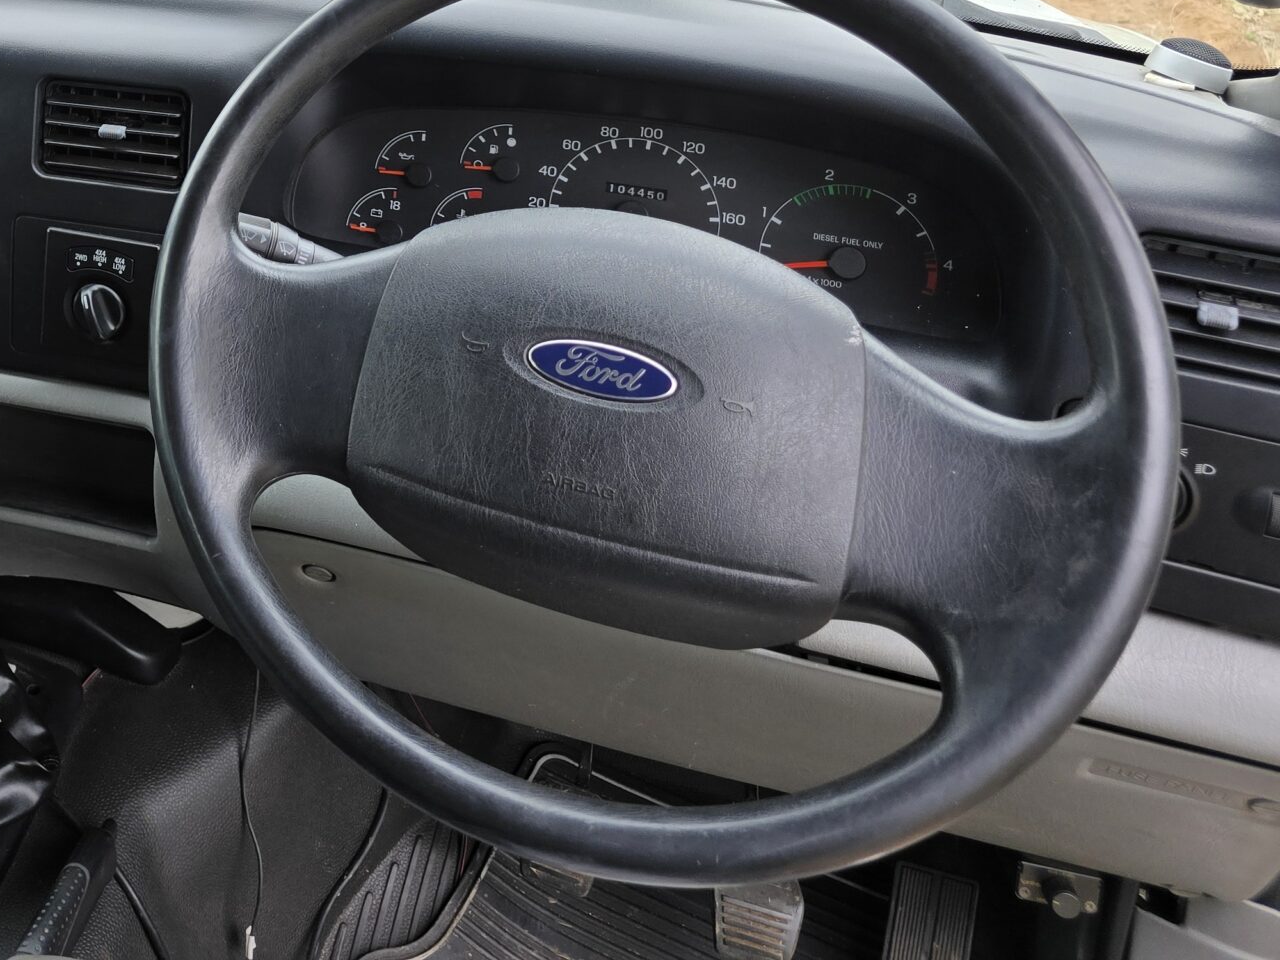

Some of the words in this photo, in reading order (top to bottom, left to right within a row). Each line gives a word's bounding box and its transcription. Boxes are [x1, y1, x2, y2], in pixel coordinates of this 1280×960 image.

[600, 126, 619, 138] 80
[640, 126, 664, 140] 100
[562, 140, 581, 152] 60
[682, 141, 706, 155] 120
[538, 165, 558, 178] 40
[824, 169, 835, 181] 2
[712, 175, 737, 190] 140
[609, 183, 665, 201] 104450
[528, 196, 546, 208] 20
[907, 192, 917, 205] 3
[390, 200, 401, 211] 18
[762, 206, 767, 218] 1
[722, 212, 746, 226] 160
[813, 232, 839, 244] DIESEL
[841, 236, 861, 247] FUEL
[862, 240, 884, 249] ONLY
[74, 253, 88, 262] 2WD
[92, 254, 107, 263] HIGH
[112, 262, 127, 271] LOW
[943, 259, 953, 271] 4
[555, 344, 647, 392] Ford
[544, 471, 617, 501] AIRBAG
